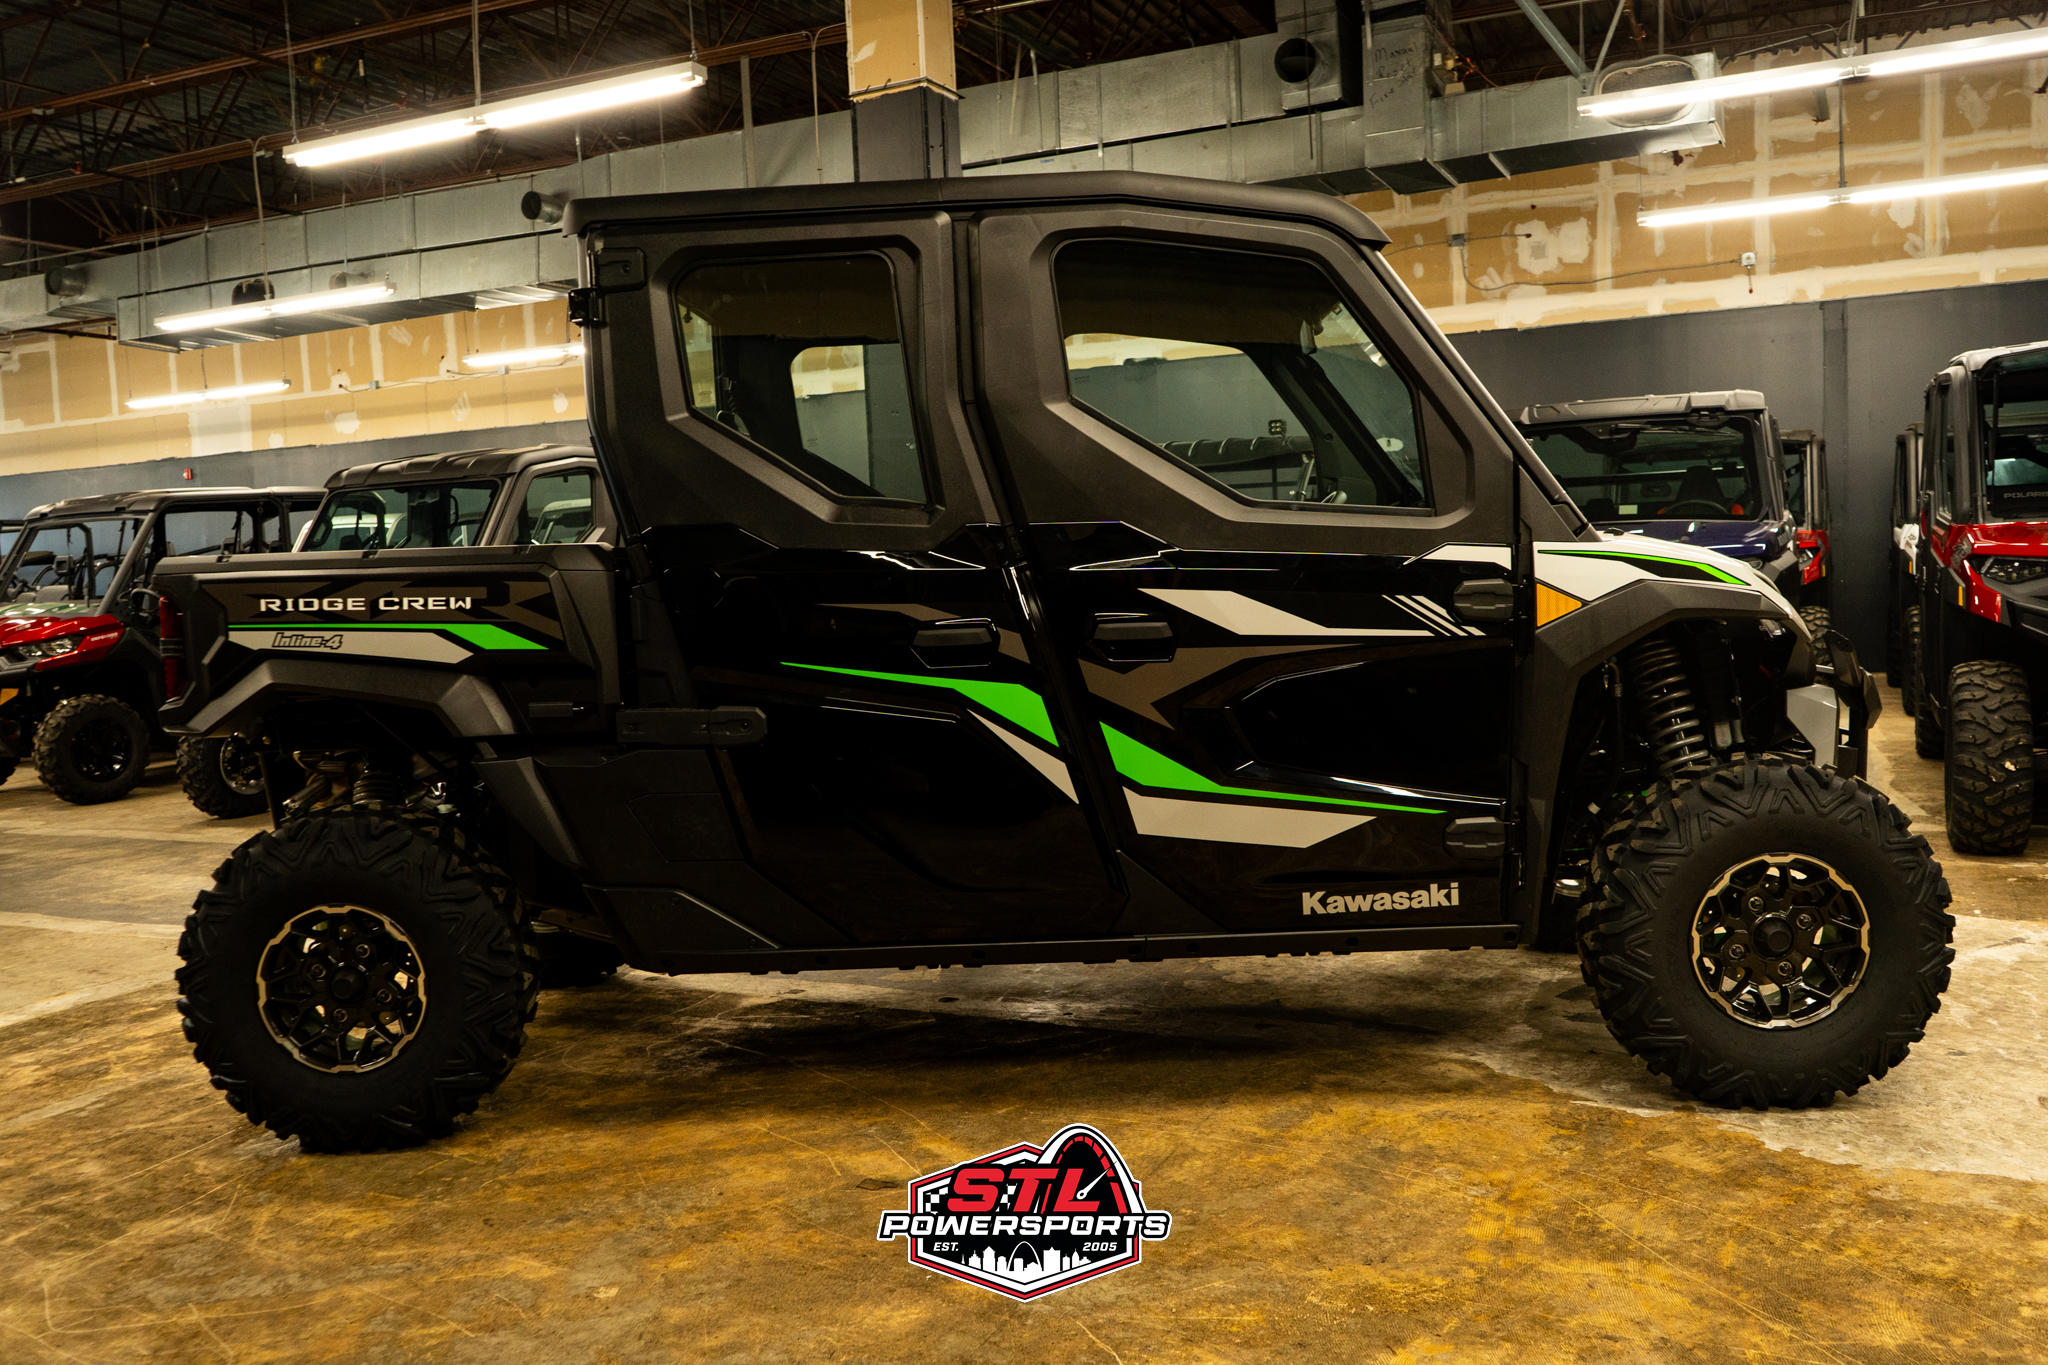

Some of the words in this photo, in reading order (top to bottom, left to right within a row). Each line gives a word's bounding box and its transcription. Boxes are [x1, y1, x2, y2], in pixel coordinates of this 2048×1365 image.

[2003, 491, 2048, 499] POLARIS
[260, 598, 366, 611] RIDGE
[379, 597, 472, 610] CREW
[272, 632, 343, 649] Inline-4
[1302, 882, 1459, 915] Kawasaki
